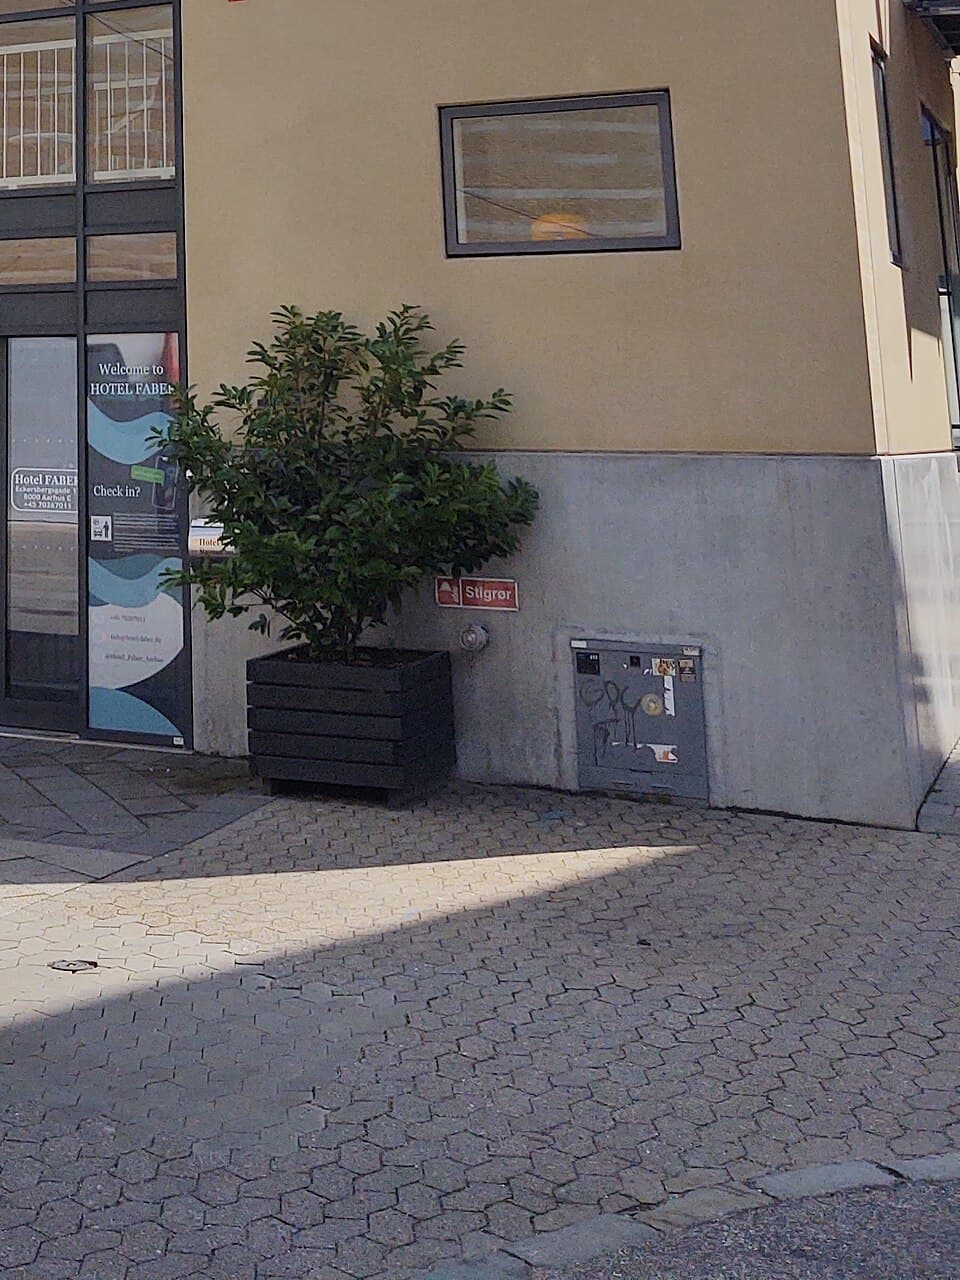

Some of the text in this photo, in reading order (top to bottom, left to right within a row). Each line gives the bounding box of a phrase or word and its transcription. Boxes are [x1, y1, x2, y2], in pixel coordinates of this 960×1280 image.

[98, 362, 164, 376] Welcome to
[90, 382, 133, 395] HOTEL
[15, 473, 43, 485] Hotel
[23, 493, 41, 501] 8000
[42, 494, 65, 502] Aarhus
[93, 484, 141, 498] Check in?
[465, 584, 512, 602] Stigrør
